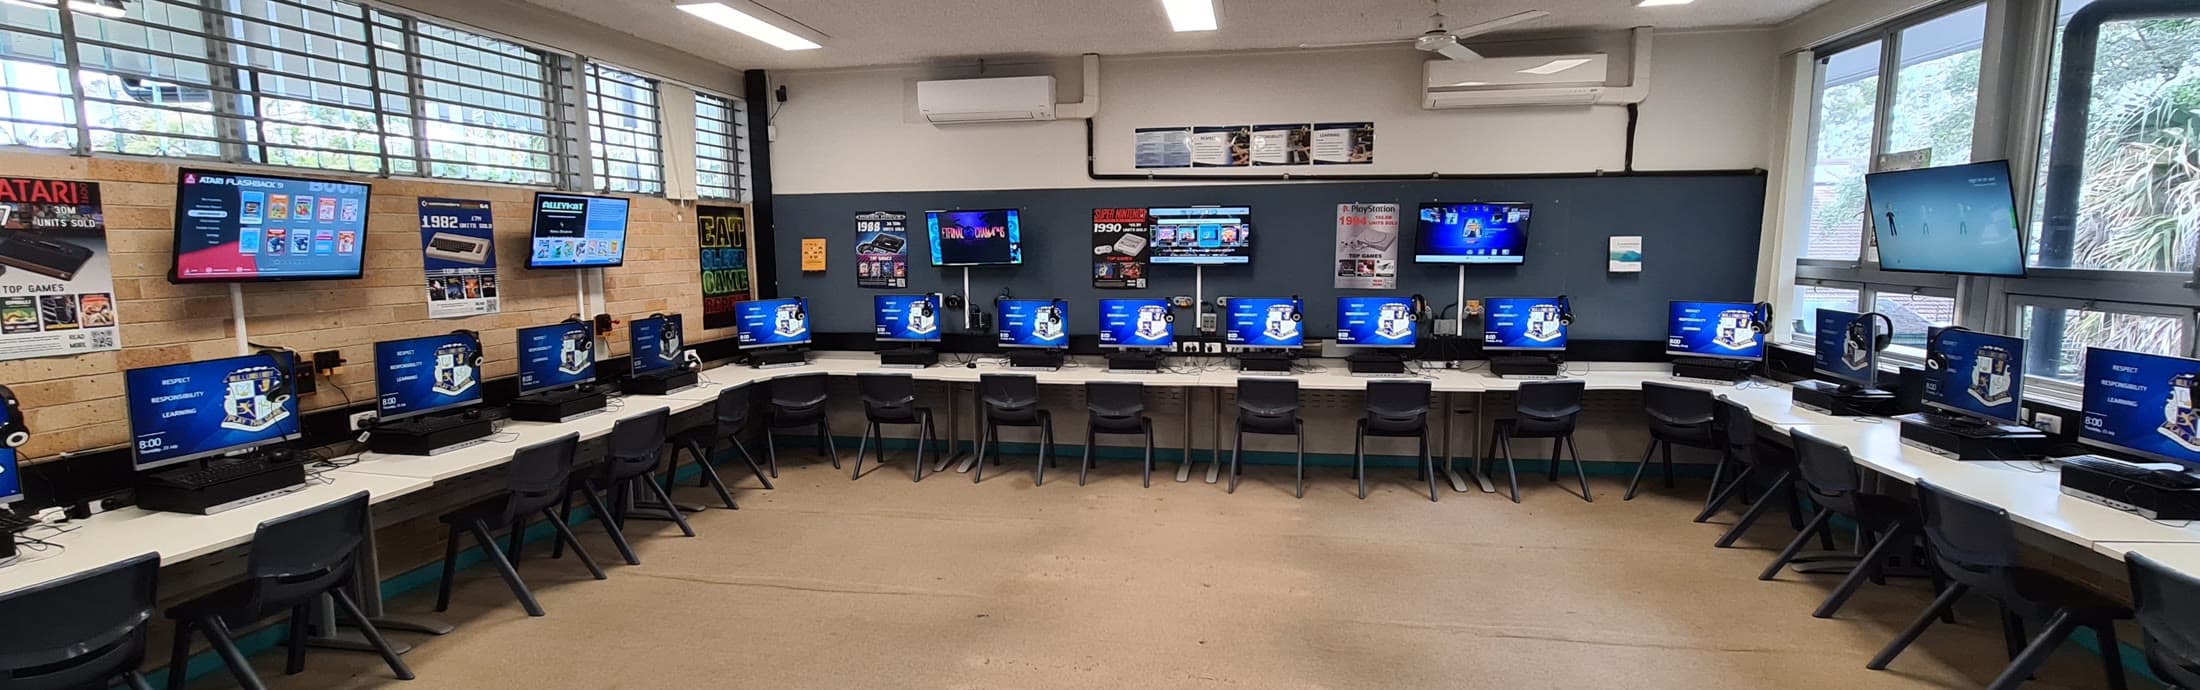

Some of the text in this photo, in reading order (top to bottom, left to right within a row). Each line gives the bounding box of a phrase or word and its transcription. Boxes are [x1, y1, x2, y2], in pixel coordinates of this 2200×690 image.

[199, 176, 224, 185] ATARI
[0, 178, 78, 204] ATARI
[54, 206, 76, 215] 30M
[1351, 205, 1396, 215] PlayStation
[37, 219, 96, 228] UNITS SOLD
[421, 215, 459, 228] 1982
[699, 215, 745, 248] EAT
[1094, 223, 1122, 233] 1990
[701, 248, 746, 270] SLEEP
[703, 268, 749, 295] GAME
[2, 283, 65, 294] TOP GAMES
[2112, 364, 2139, 374] RESPECT
[162, 376, 191, 386] RESPECT
[2101, 378, 2148, 392] RESPONSIBILITY
[151, 391, 205, 404] RESPONSIBILITY
[382, 397, 397, 406] 8:00
[2107, 396, 2139, 408] LEARNING
[162, 407, 197, 419] LEARNING
[2084, 416, 2103, 428] 8:00
[138, 437, 162, 450] 8:00
